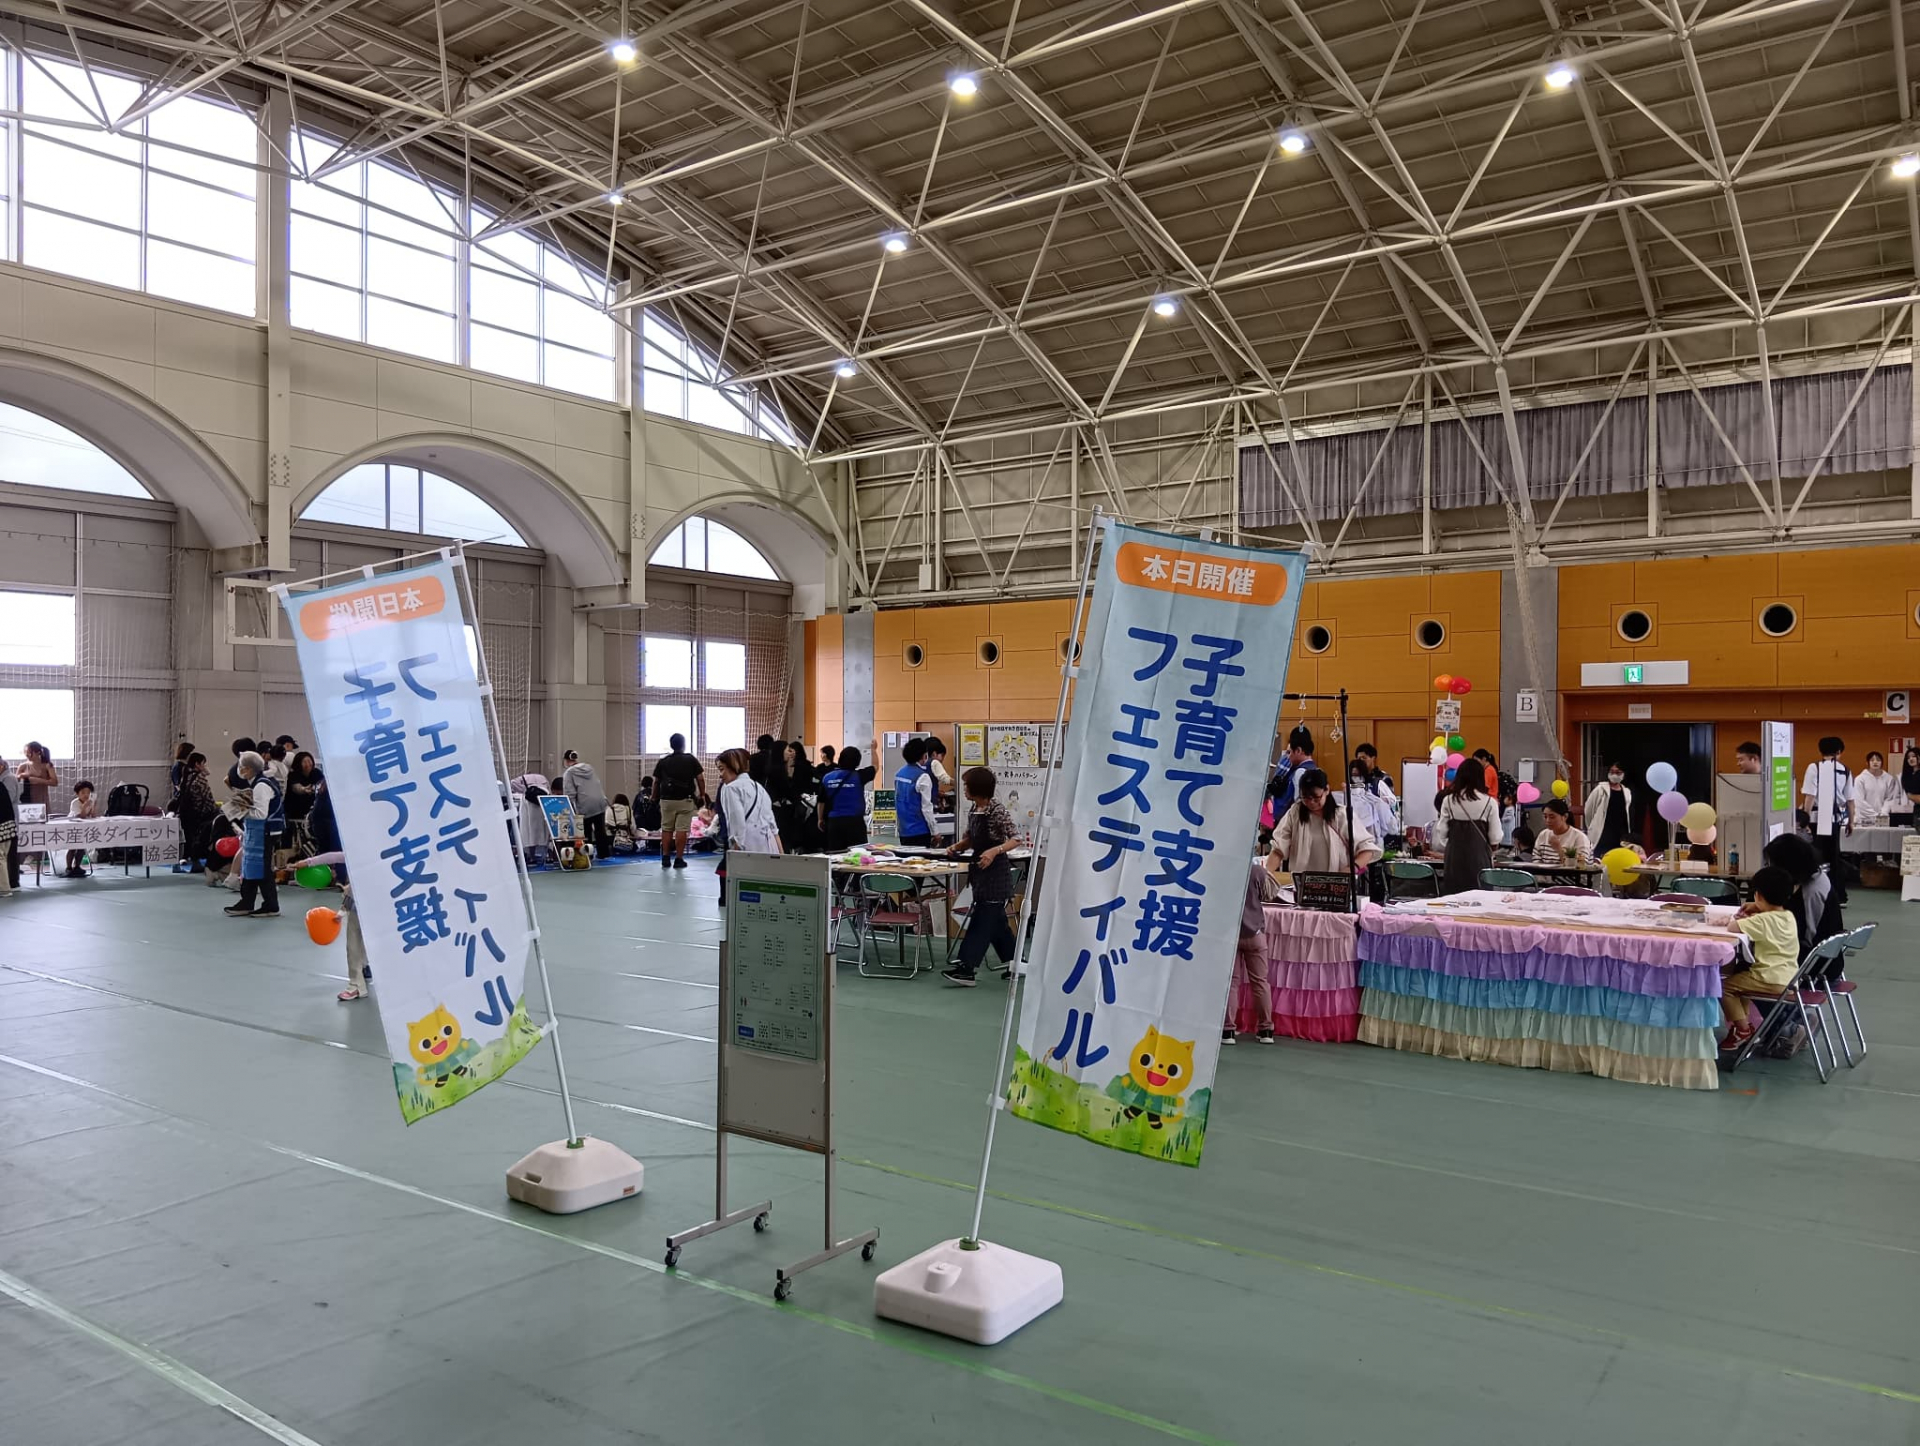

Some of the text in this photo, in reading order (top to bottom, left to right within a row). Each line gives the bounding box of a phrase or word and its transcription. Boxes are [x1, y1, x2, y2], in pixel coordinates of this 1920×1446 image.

[1141, 555, 1256, 597] 本日開催
[1520, 696, 1533, 712] B
[1887, 692, 1906, 712] C
[1132, 634, 1246, 961] 子育て支援
[144, 843, 178, 862] 協会
[1053, 627, 1178, 1067] フェスティバル
